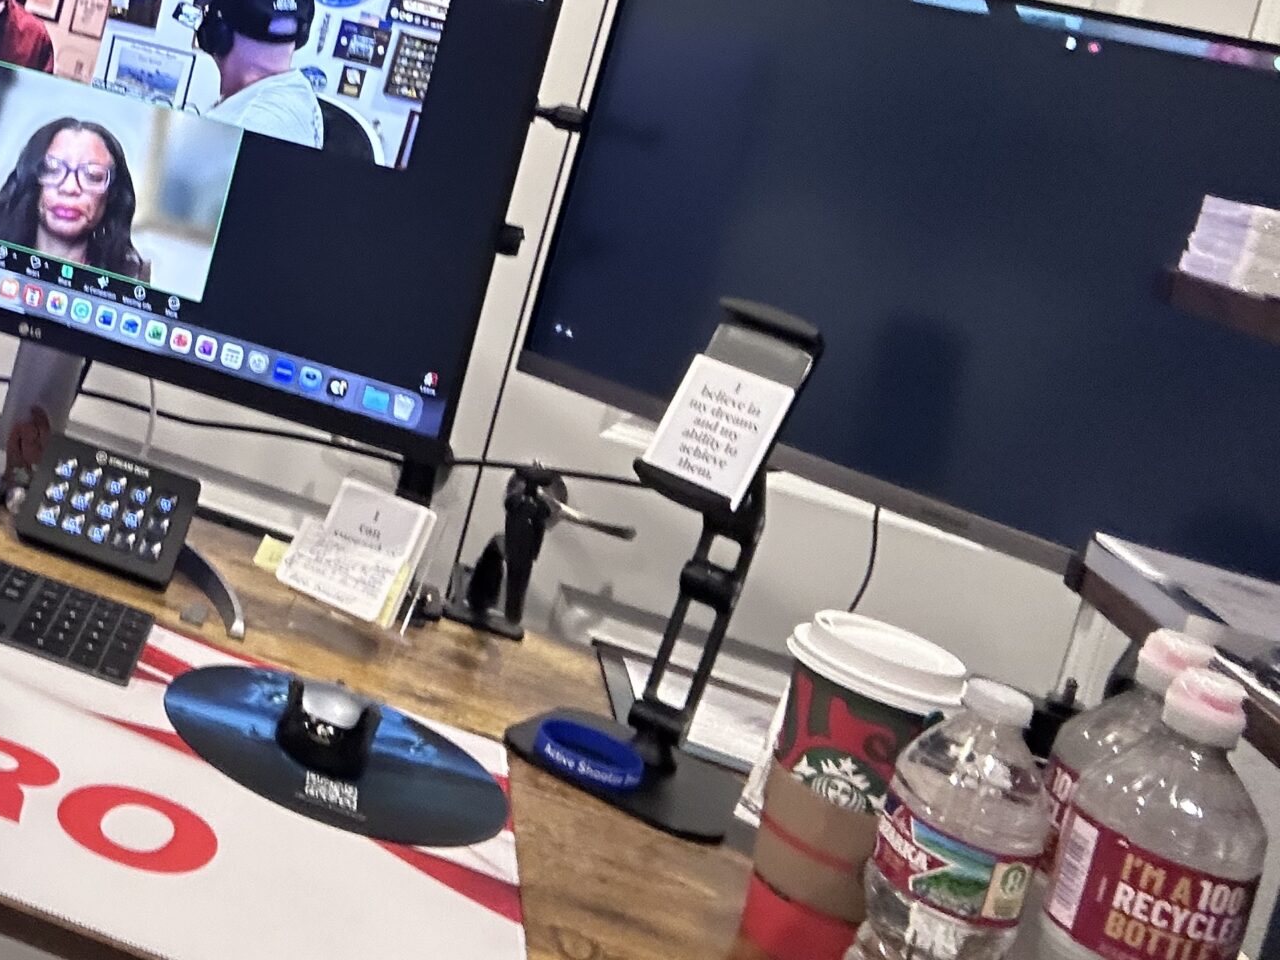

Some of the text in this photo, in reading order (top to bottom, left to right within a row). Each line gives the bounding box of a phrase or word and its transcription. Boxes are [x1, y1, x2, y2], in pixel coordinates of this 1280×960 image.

[701, 384, 761, 417] believe in
[690, 400, 758, 432] my dreams
[694, 417, 738, 442] and my
[680, 443, 727, 469] achieve
[682, 428, 738, 457] ability to
[678, 457, 712, 480] them.
[544, 743, 575, 770] Active
[1122, 853, 1167, 896] I'M
[1171, 876, 1192, 908] A
